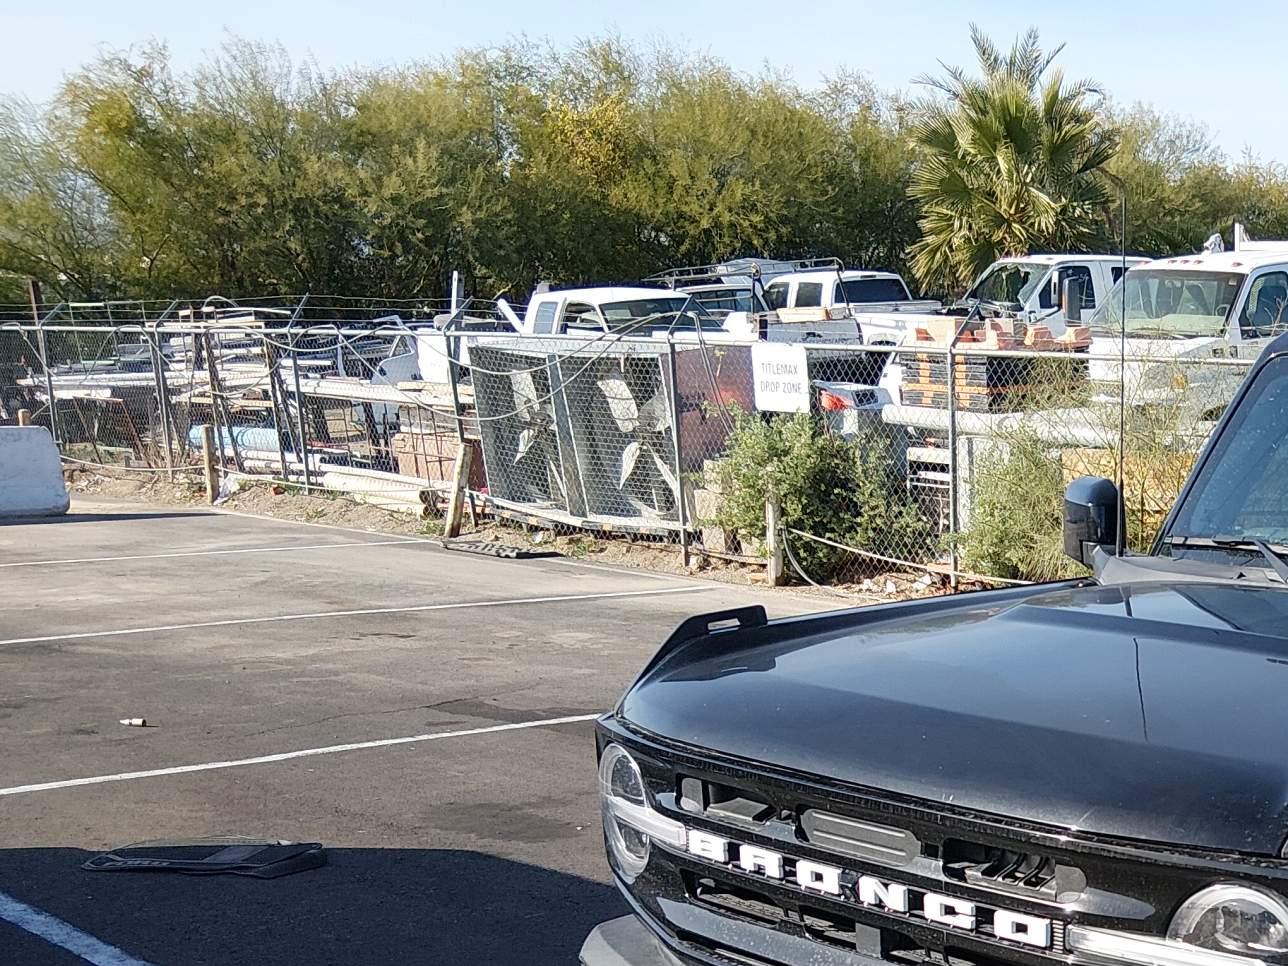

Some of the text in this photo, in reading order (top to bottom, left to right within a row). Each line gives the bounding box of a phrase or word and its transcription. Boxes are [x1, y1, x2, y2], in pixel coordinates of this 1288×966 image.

[761, 362, 798, 375] TITLEMAX
[760, 381, 802, 394] DROP ZONE
[689, 829, 1051, 946] BRONCO
